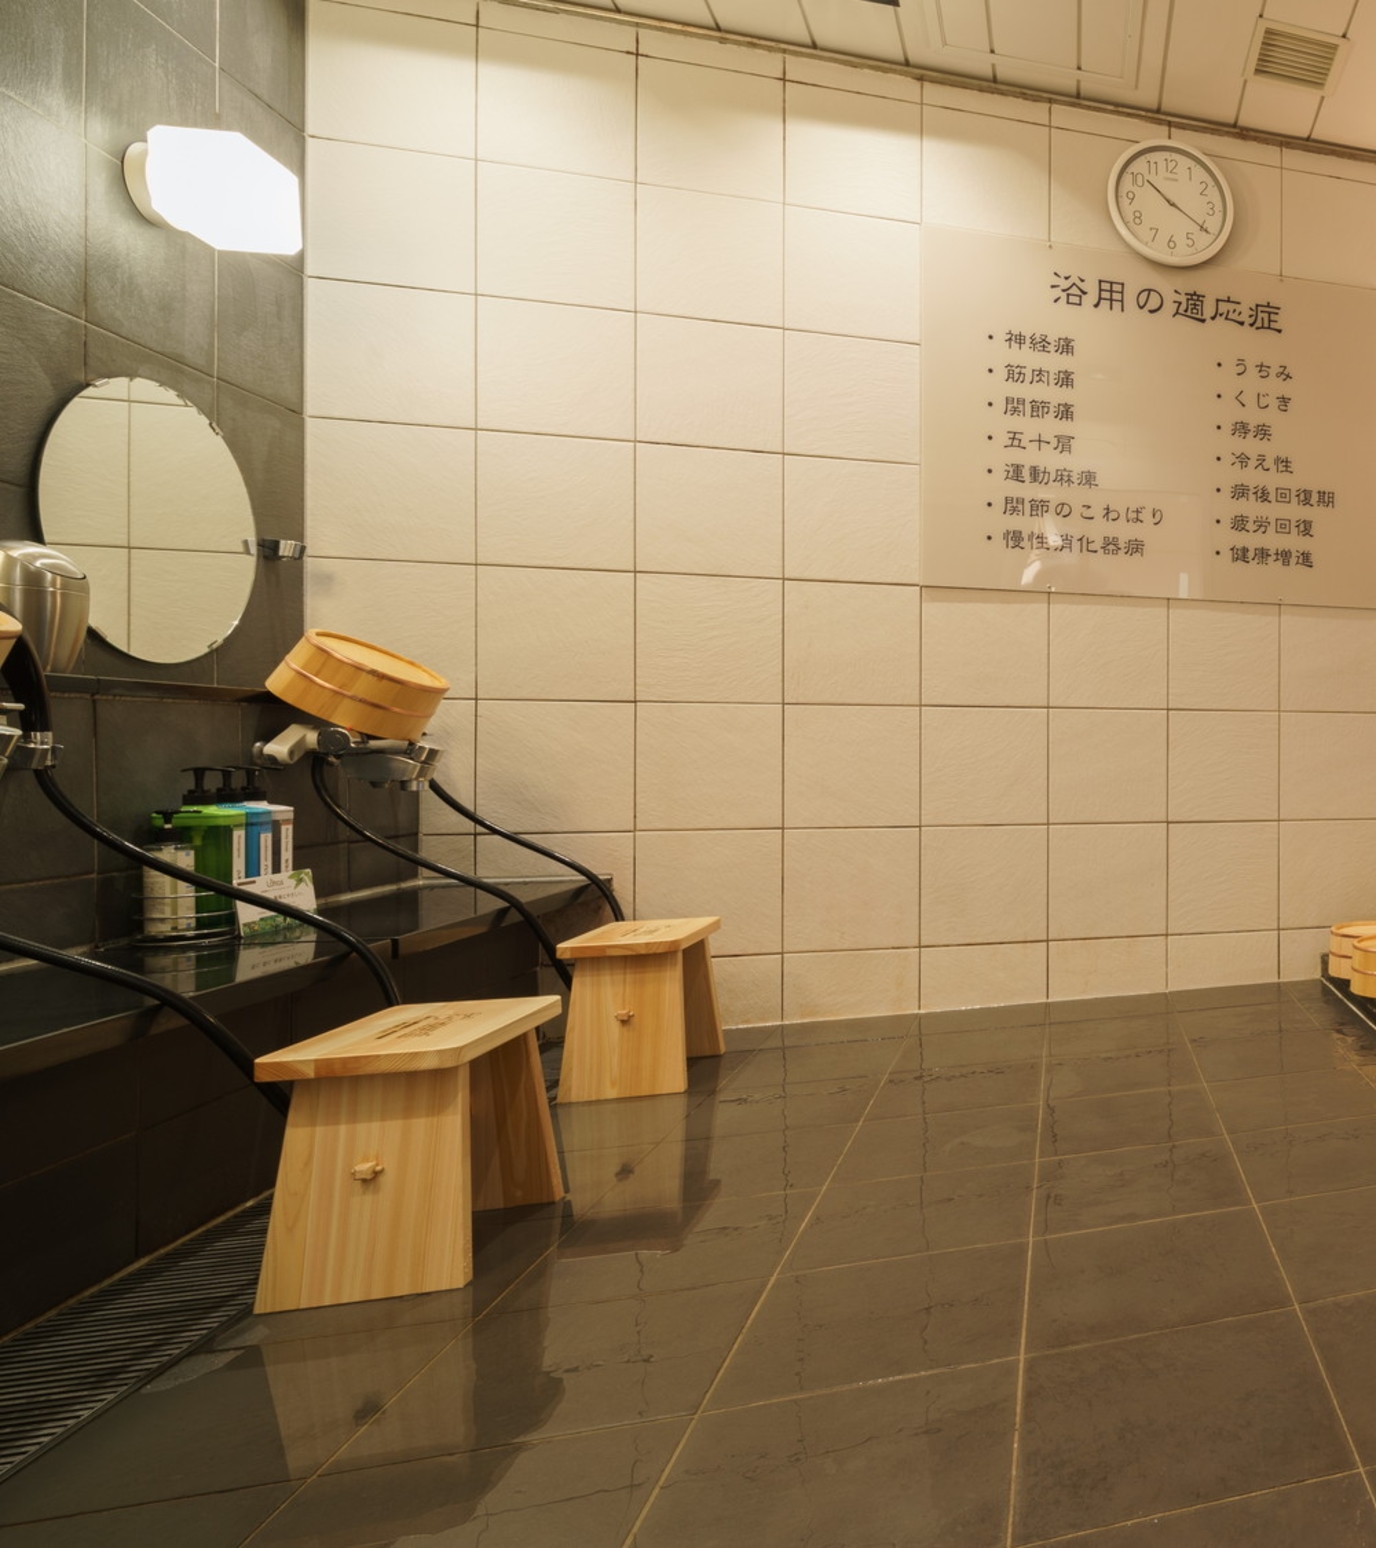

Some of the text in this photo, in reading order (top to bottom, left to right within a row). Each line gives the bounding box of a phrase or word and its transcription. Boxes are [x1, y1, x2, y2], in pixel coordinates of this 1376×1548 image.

[1146, 161, 1158, 176] 11
[1164, 158, 1178, 175] 12
[1187, 166, 1192, 182] 1
[1130, 172, 1145, 187] 10
[1200, 181, 1208, 197] 2
[1126, 191, 1135, 206] 9
[1206, 202, 1216, 216] 3
[1133, 210, 1142, 226] 8
[1149, 227, 1159, 242] 7
[1167, 234, 1176, 249] 6
[1186, 232, 1195, 248] 5
[1049, 271, 1283, 334] 浴用の適応症
[1003, 330, 1075, 356] 神経痛
[1003, 362, 1075, 389] 筋肉痛
[1233, 358, 1293, 381] うちみ
[1002, 396, 1074, 421] 関節痛
[1233, 391, 1292, 412] くじき
[1229, 420, 1273, 440] 痔疾
[1003, 430, 1075, 454] 五十肩
[1229, 451, 1293, 474] 冷え性
[1003, 462, 1099, 488] 運動麻痺
[1229, 483, 1335, 509] 病後回復期
[1002, 496, 1164, 525] 関節のこわばり
[1229, 514, 1314, 537] 疲労回復
[1229, 545, 1314, 568] 健康増進
